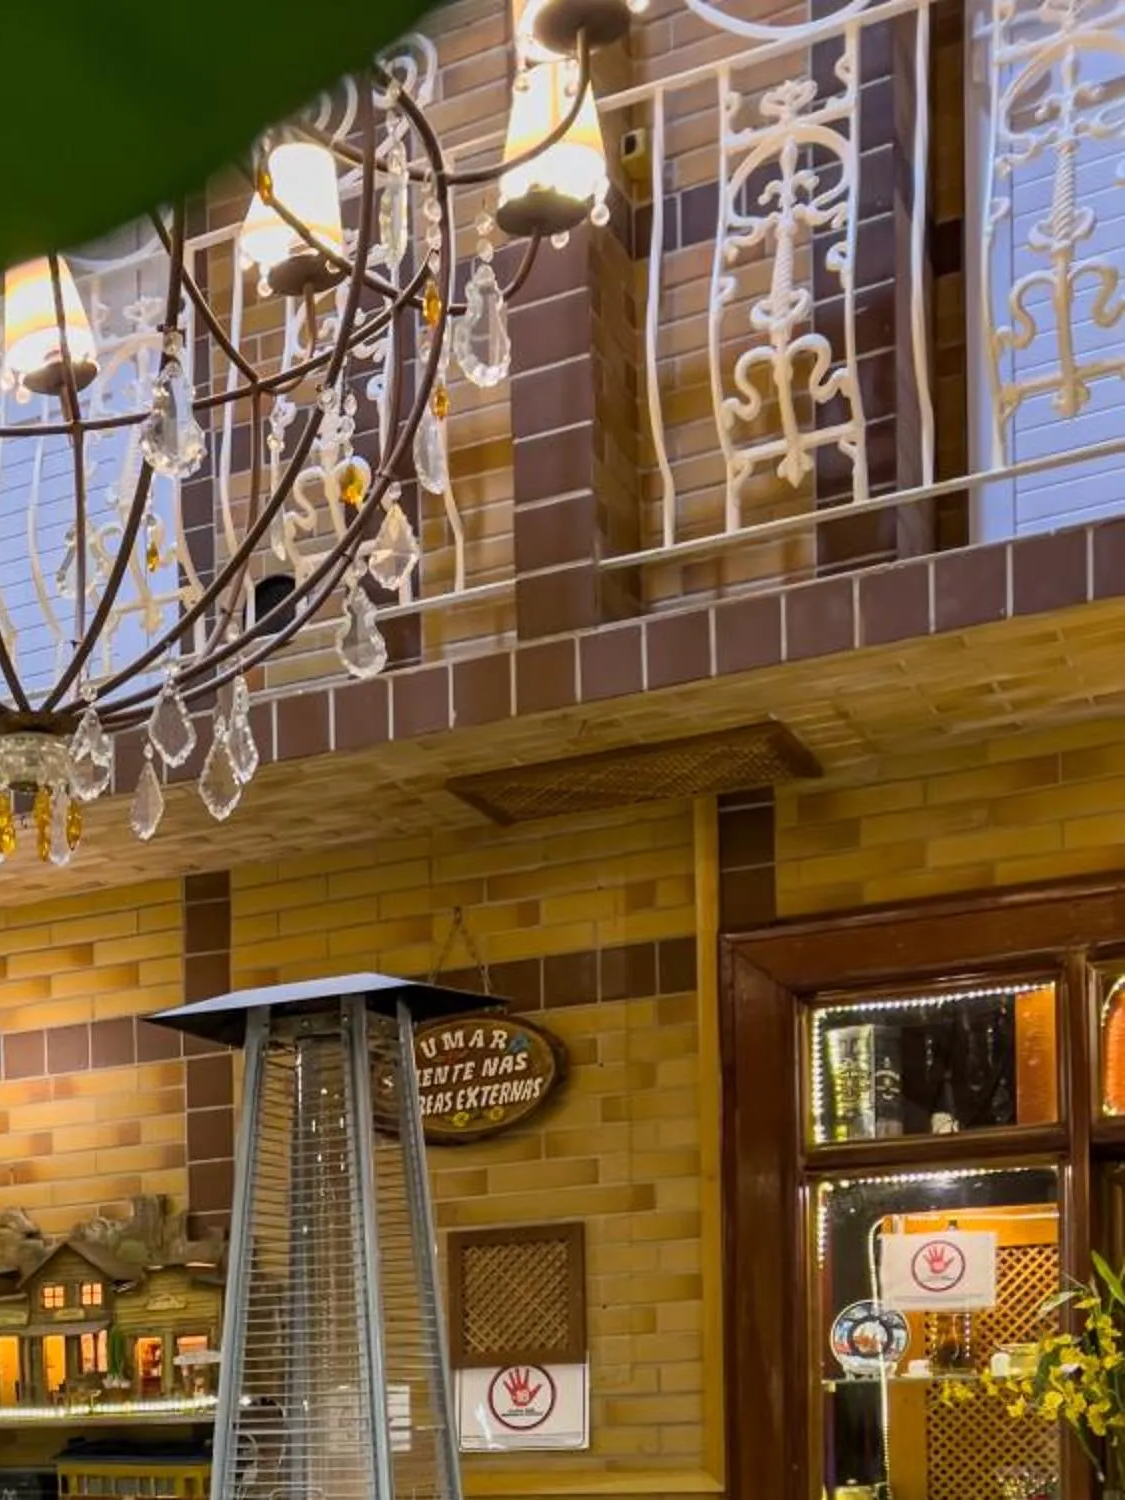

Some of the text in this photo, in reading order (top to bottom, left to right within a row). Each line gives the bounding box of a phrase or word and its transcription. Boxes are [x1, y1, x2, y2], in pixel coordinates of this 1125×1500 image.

[419, 1029, 508, 1059] UMAR
[481, 1051, 529, 1077] NAS
[419, 1077, 544, 1116] REAS EXTERNAS
